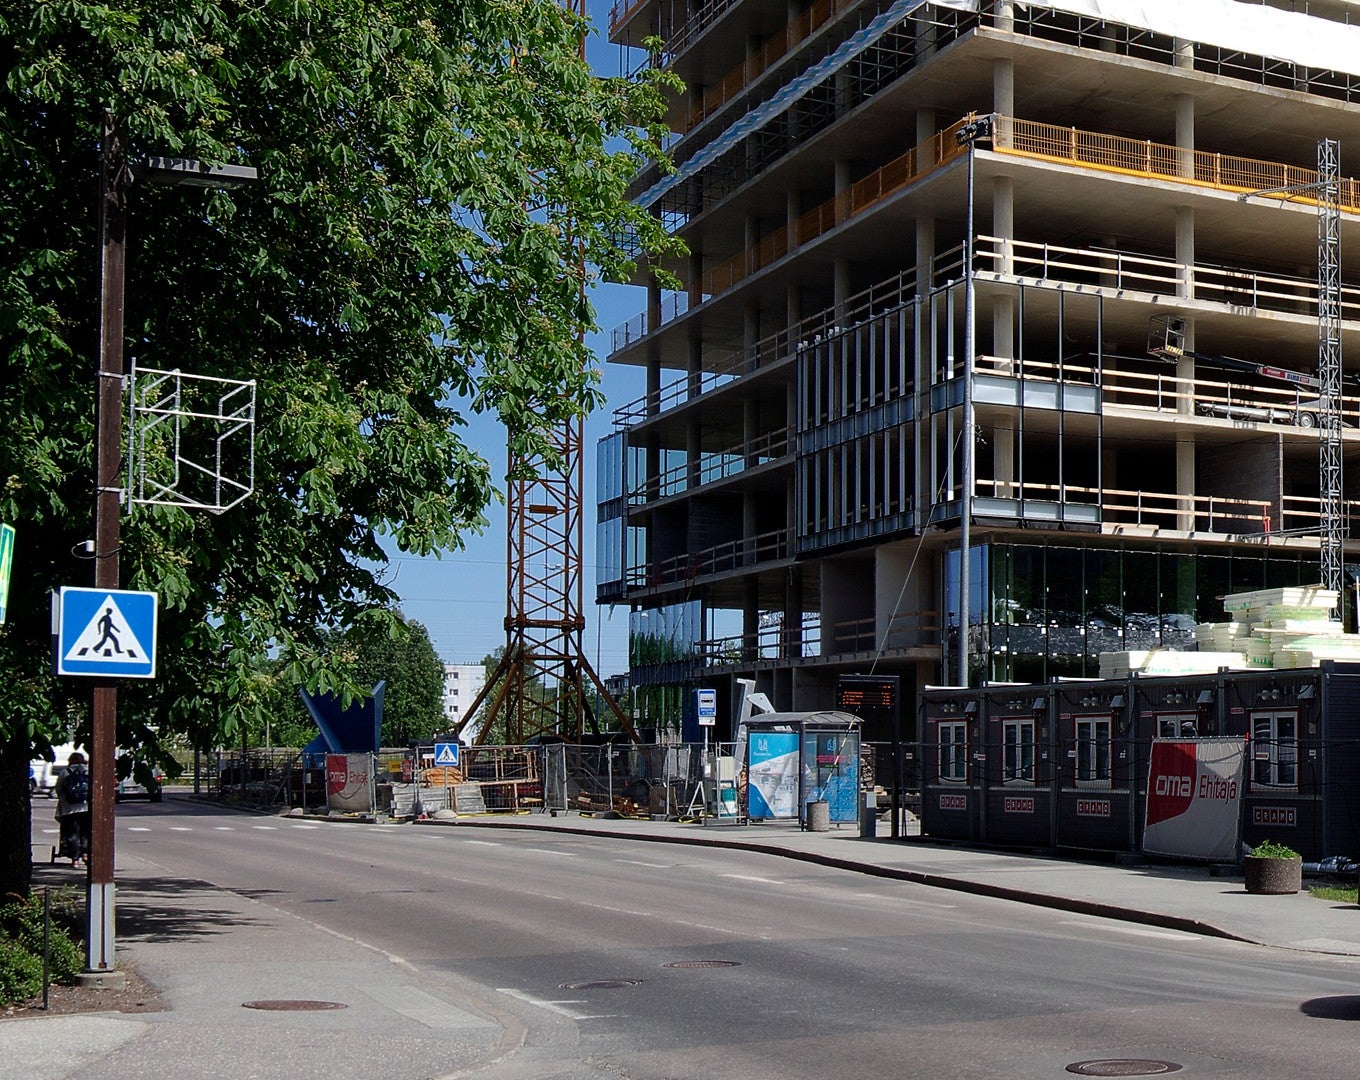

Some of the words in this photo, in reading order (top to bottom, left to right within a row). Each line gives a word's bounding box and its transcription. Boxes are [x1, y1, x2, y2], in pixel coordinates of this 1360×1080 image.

[1156, 775, 1192, 797] oma
[1199, 774, 1237, 805] Ehitaja
[1255, 809, 1294, 823] CRAMO
